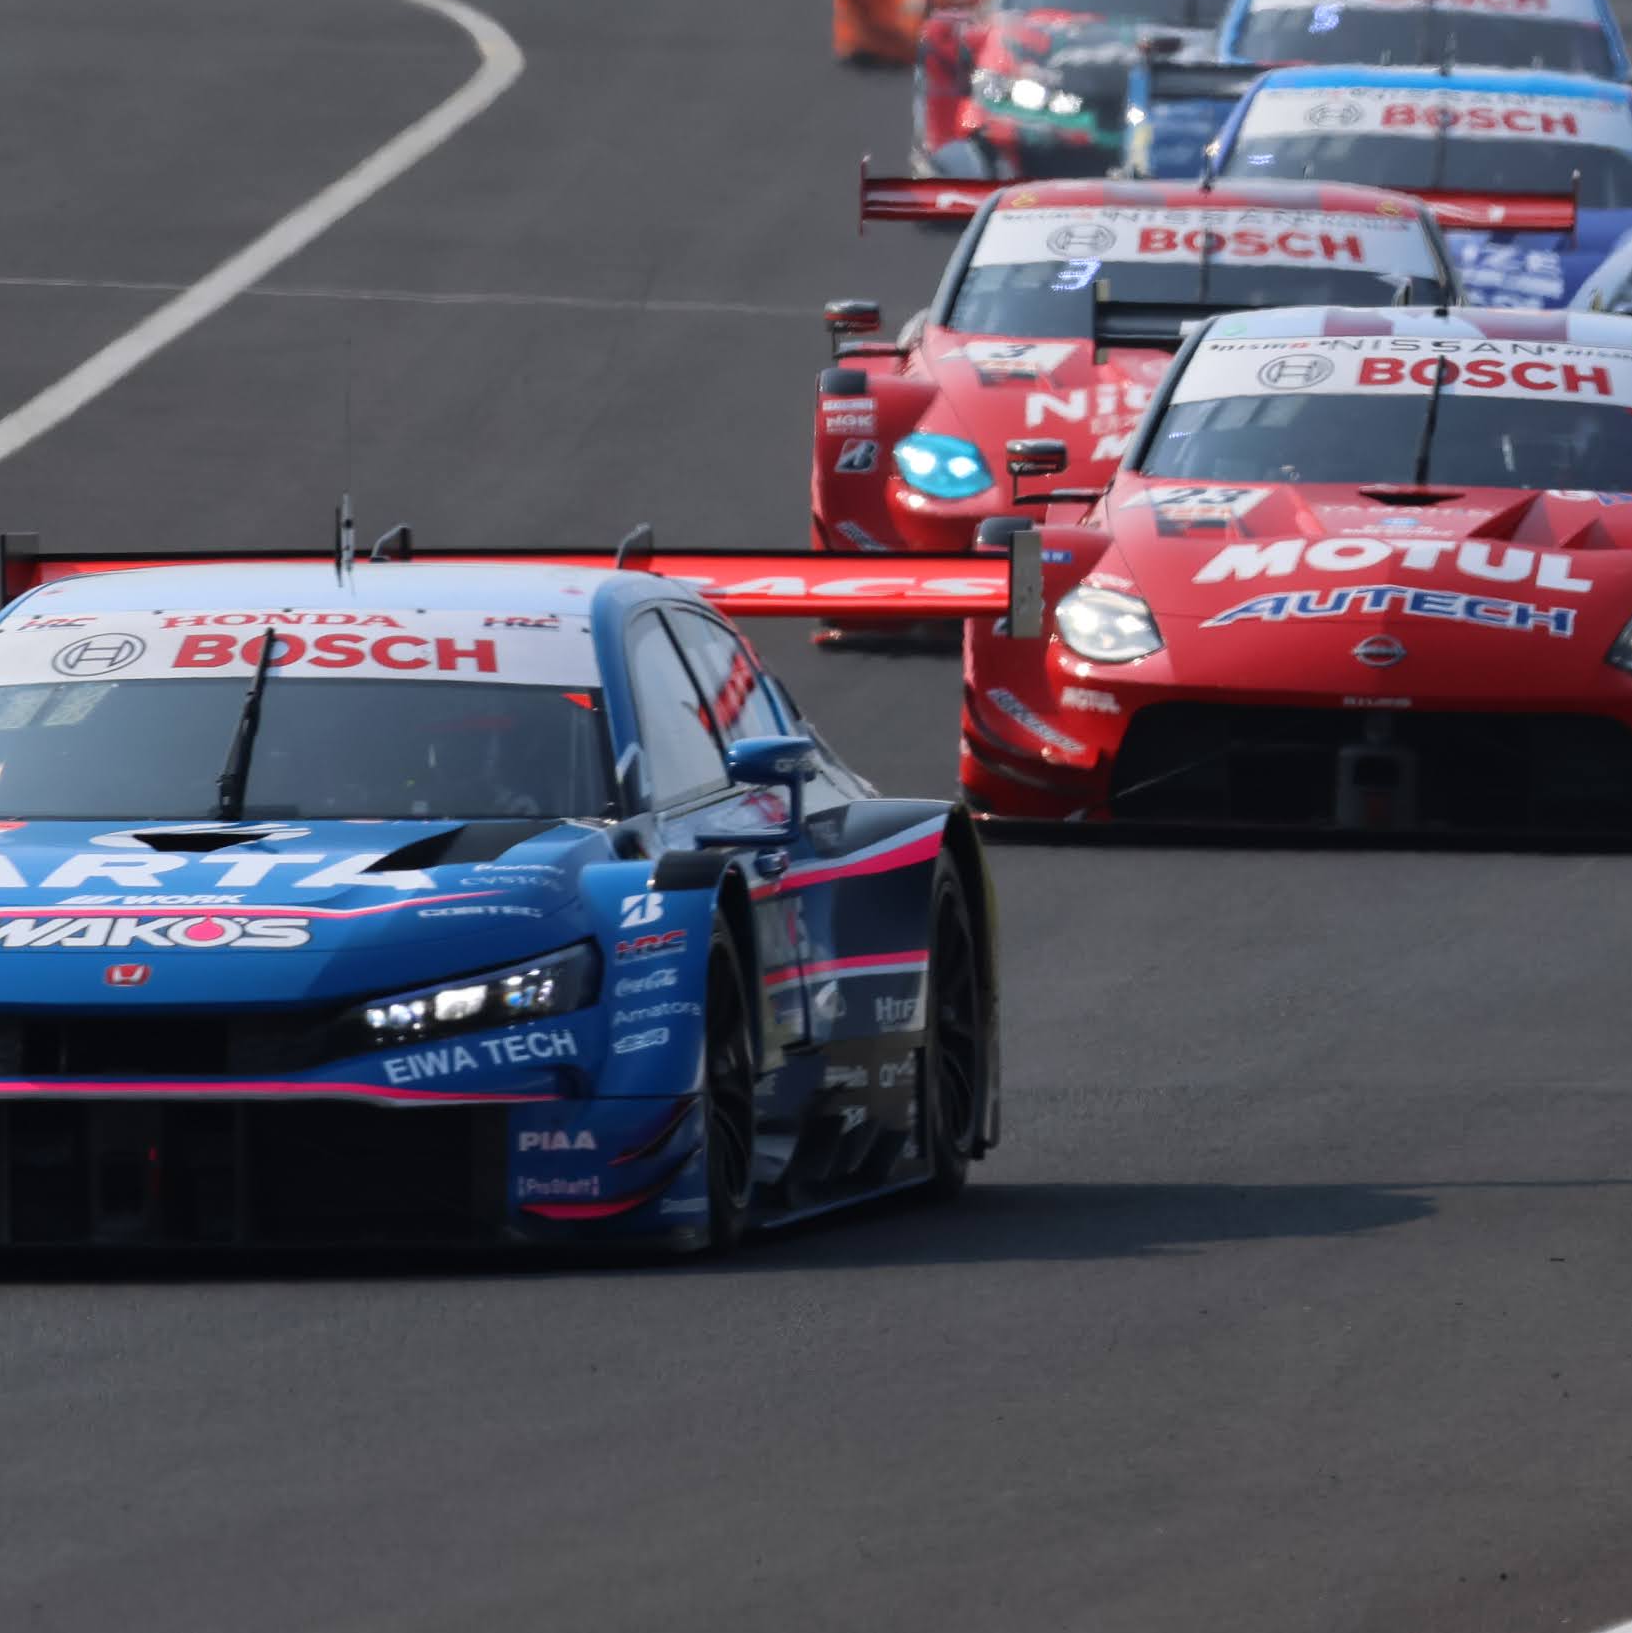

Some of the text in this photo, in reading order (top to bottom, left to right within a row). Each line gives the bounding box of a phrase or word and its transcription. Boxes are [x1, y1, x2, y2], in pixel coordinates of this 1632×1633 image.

[1380, 103, 1579, 136] BOSCH
[1138, 227, 1363, 264] BOSCH
[1050, 256, 1102, 293] 3
[1327, 339, 1543, 356] NISSAN
[1358, 357, 1613, 396] BOSCH
[1191, 537, 1593, 593] MOTUL
[159, 613, 406, 629] HONDA
[1199, 584, 1578, 640] AUTECH
[171, 633, 498, 673] BOSCH
[118, 894, 248, 905] WORK
[384, 1045, 480, 1085] EIWA
[479, 1028, 579, 1065] TECH
[518, 1131, 598, 1152] PIAA
